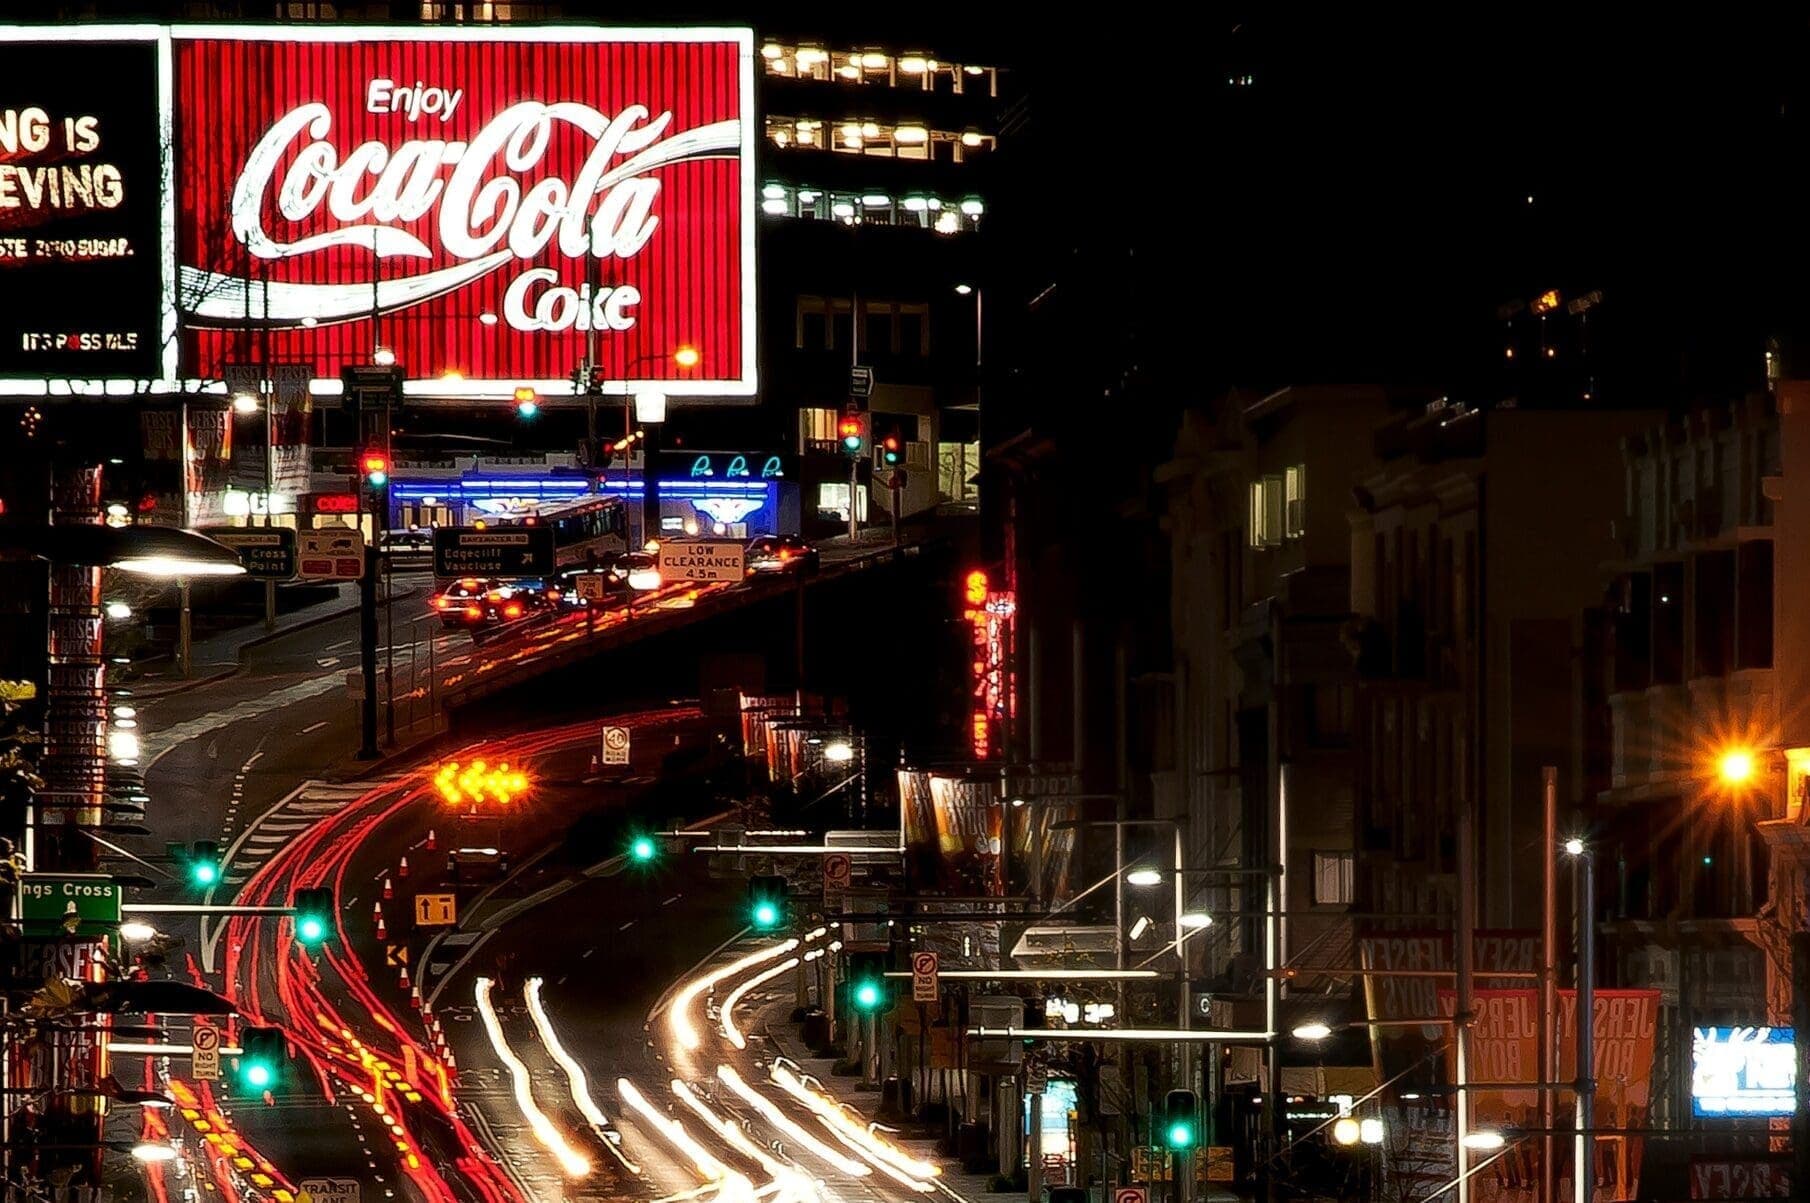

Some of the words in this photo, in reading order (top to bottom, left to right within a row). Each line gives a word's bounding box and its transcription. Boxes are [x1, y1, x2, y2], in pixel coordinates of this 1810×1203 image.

[367, 79, 463, 121] Enjoy
[65, 116, 100, 152] IS
[503, 269, 641, 332] Coke
[56, 333, 138, 350] POSSBLE
[688, 546, 714, 556] LOW
[664, 557, 739, 567] CLEARANCE
[686, 569, 717, 579] 4.5m
[23, 884, 52, 899] ngs
[63, 883, 112, 897] Cross
[198, 1052, 214, 1061] NO
[302, 1183, 358, 1194] TRANSIT
